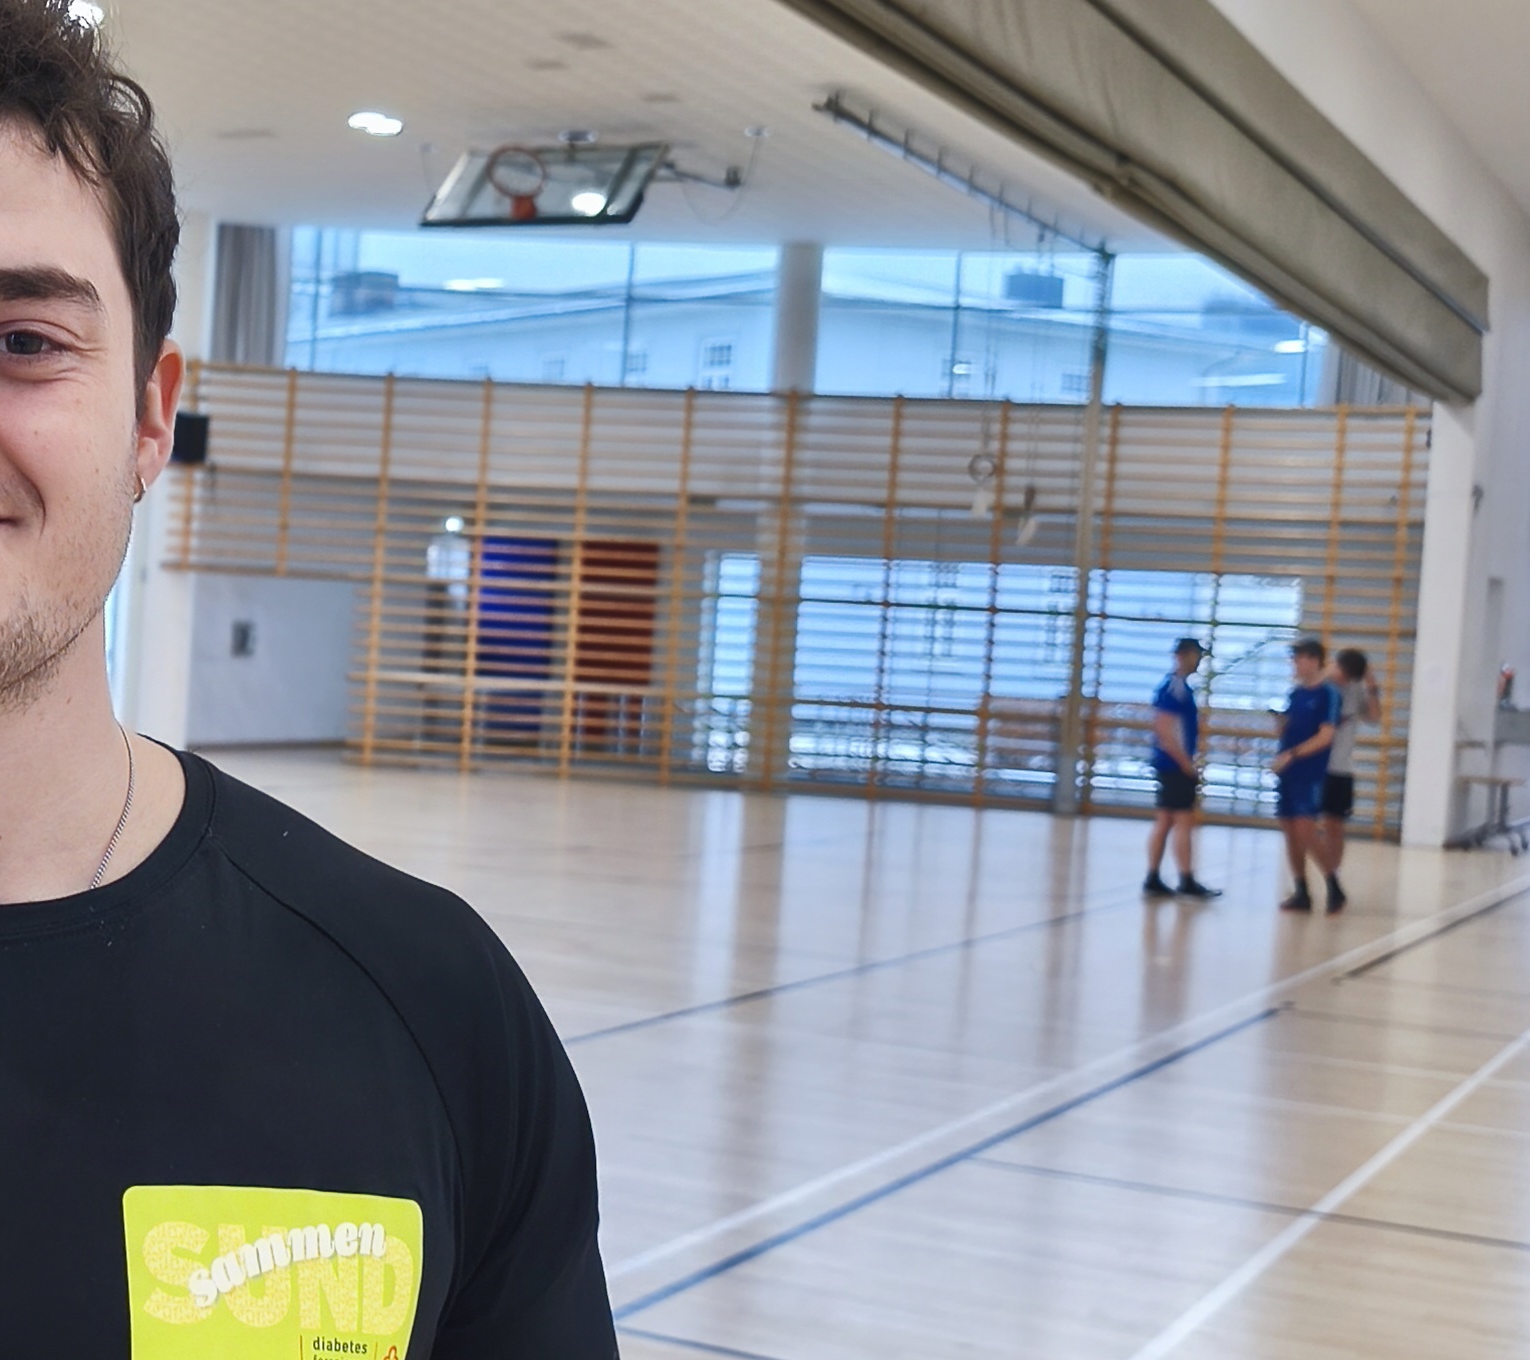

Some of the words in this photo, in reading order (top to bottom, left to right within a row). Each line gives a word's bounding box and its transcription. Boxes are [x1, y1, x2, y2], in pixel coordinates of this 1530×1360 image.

[142, 1221, 413, 1335] SUND
[188, 1222, 387, 1308] sammen
[313, 1336, 368, 1355] diabetes
